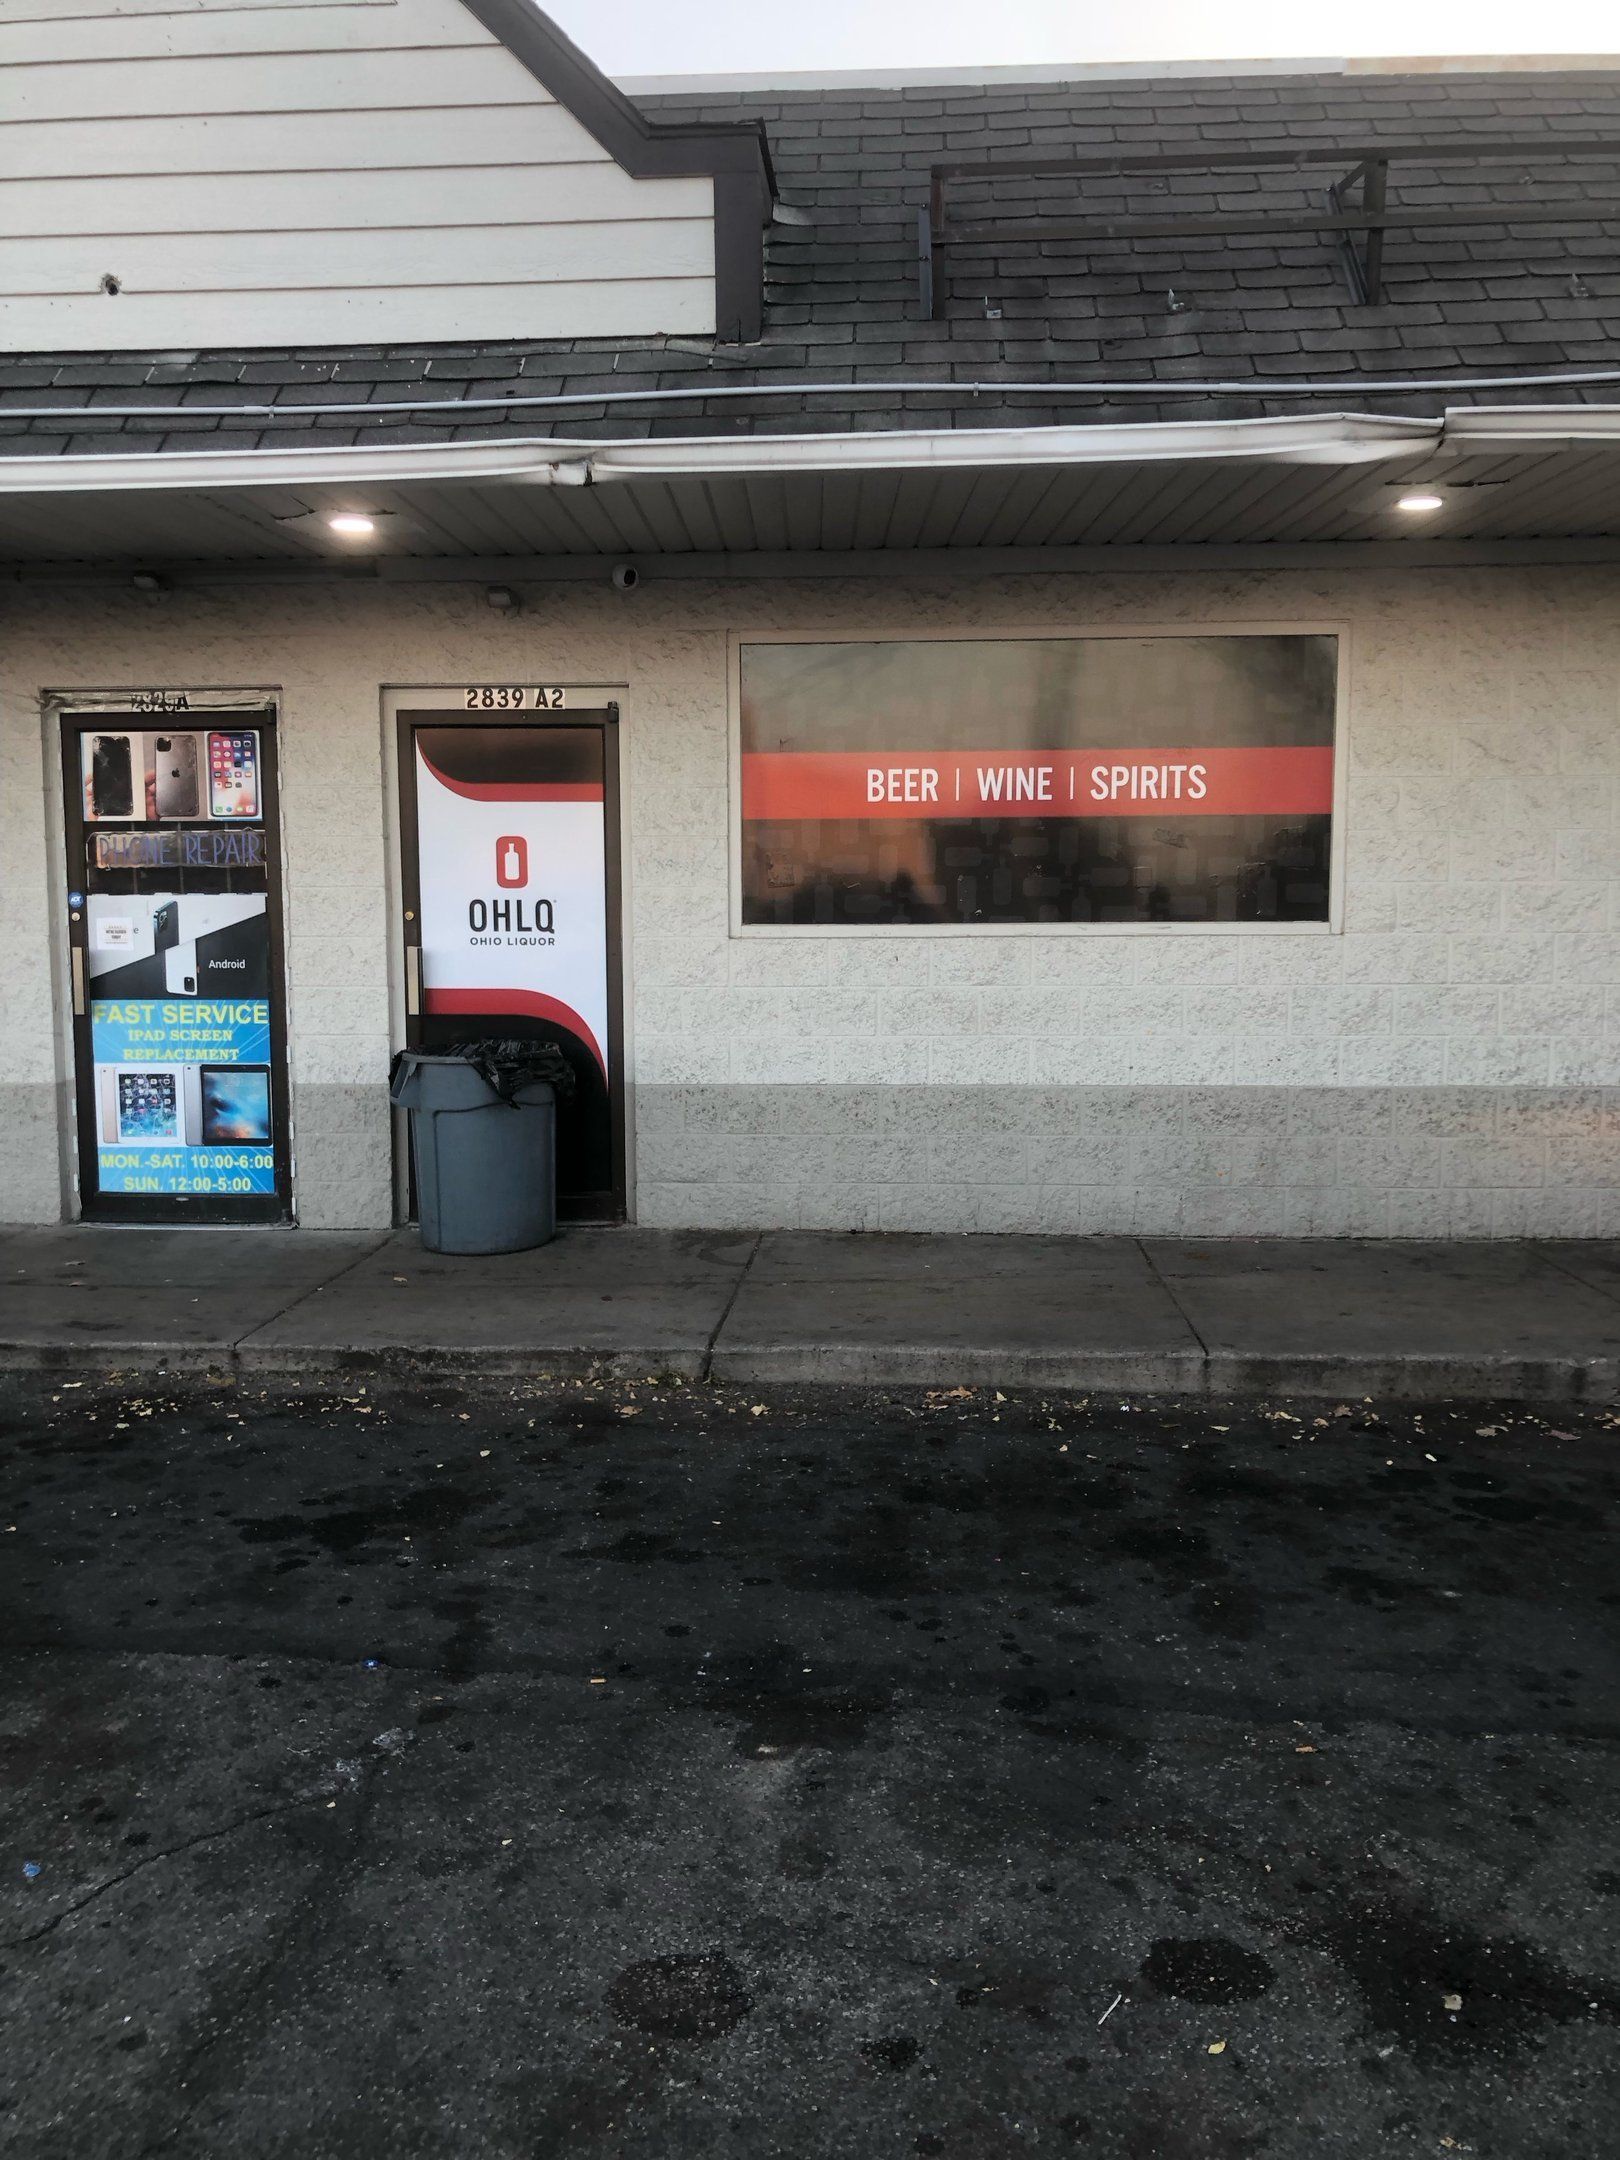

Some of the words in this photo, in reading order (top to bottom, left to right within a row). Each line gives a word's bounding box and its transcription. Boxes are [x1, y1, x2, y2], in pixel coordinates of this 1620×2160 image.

[466, 687, 524, 709] 2839
[534, 687, 564, 709] A2
[866, 768, 939, 802] BEER
[976, 767, 1053, 801] WINE
[1090, 765, 1207, 800] SPIRITS
[99, 835, 171, 866] PHONE
[184, 832, 262, 865] REPAIR
[469, 898, 555, 934] OHLQ
[469, 936, 502, 946] OHIO
[507, 936, 556, 946] LIQUOR
[208, 959, 246, 969] Android
[93, 1004, 154, 1024] FAST
[162, 1004, 270, 1024] SERVICE
[128, 1029, 165, 1042] IPAD
[170, 1029, 233, 1042] SCREEN
[123, 1048, 240, 1061] REPLACEMENT
[190, 1154, 273, 1169] 10:00-6:00
[124, 1176, 163, 1191] SUN.
[169, 1176, 252, 1191] 12:00-5:00
